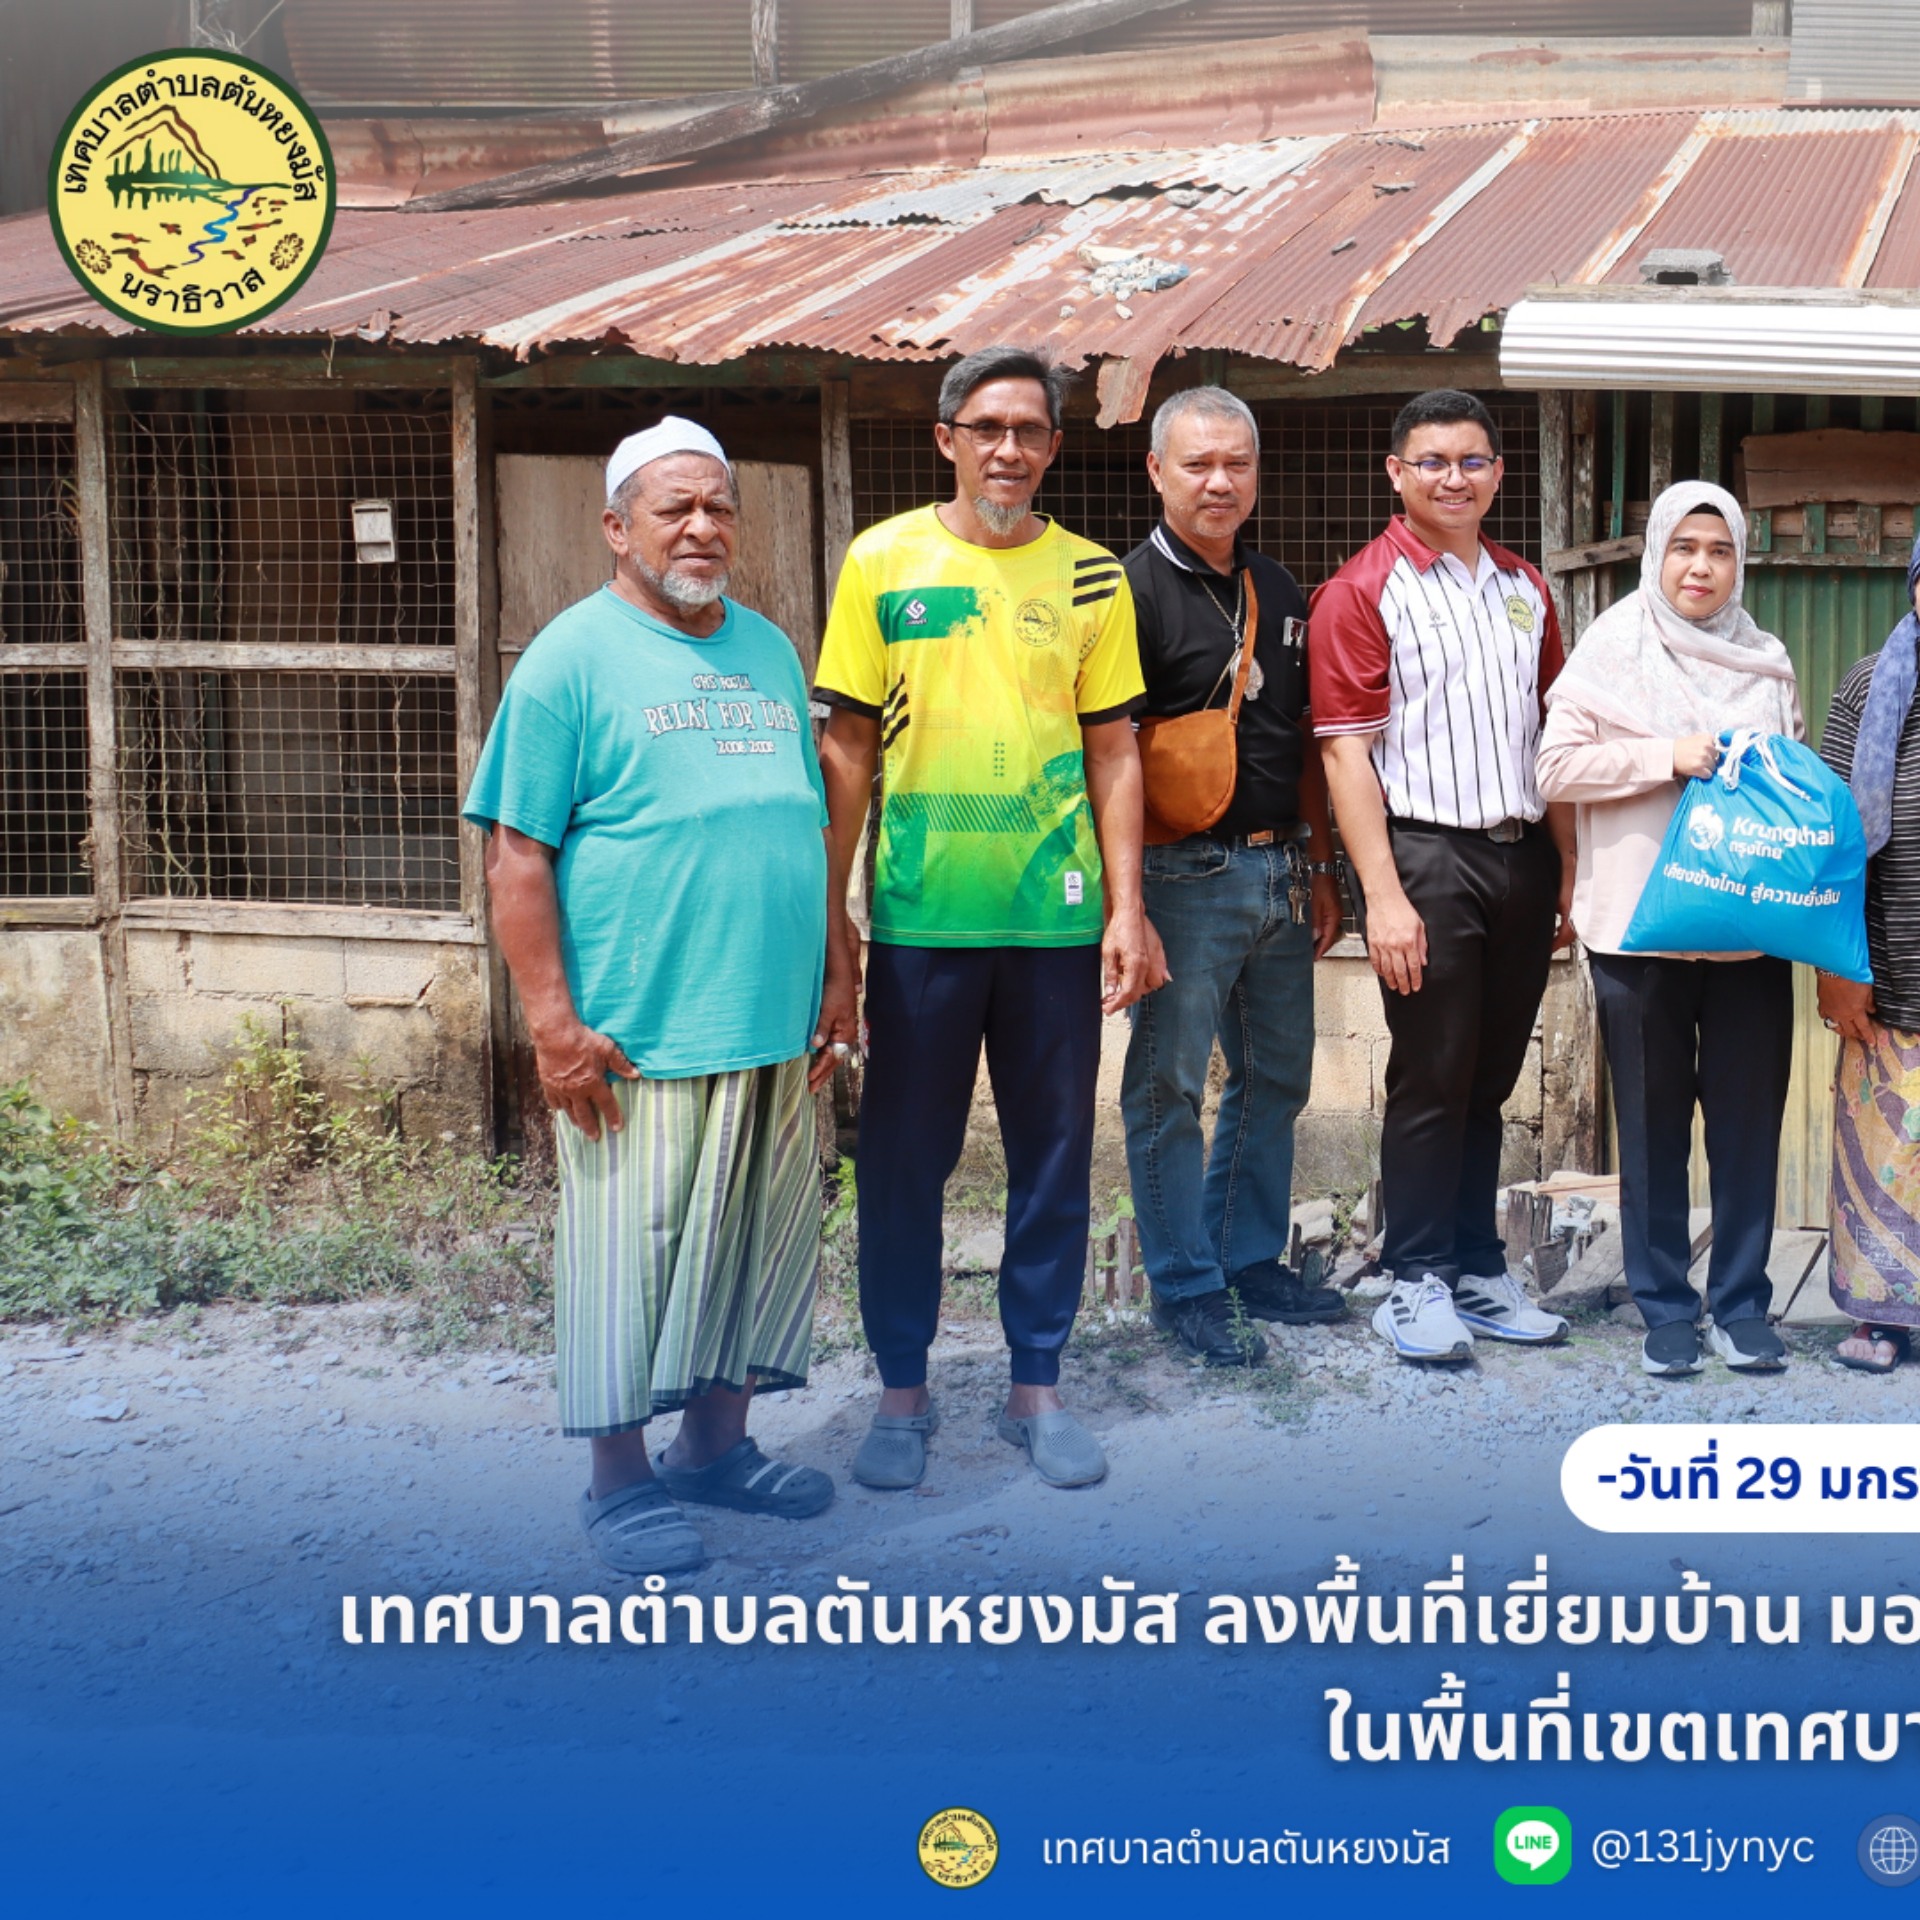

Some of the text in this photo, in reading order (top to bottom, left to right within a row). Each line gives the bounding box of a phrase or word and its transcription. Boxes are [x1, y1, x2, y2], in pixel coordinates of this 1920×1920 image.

[643, 698, 799, 740] RELAY FOR LIFE
[1732, 816, 1835, 849] Krungthai
[1729, 840, 1783, 860] กรุงไทย
